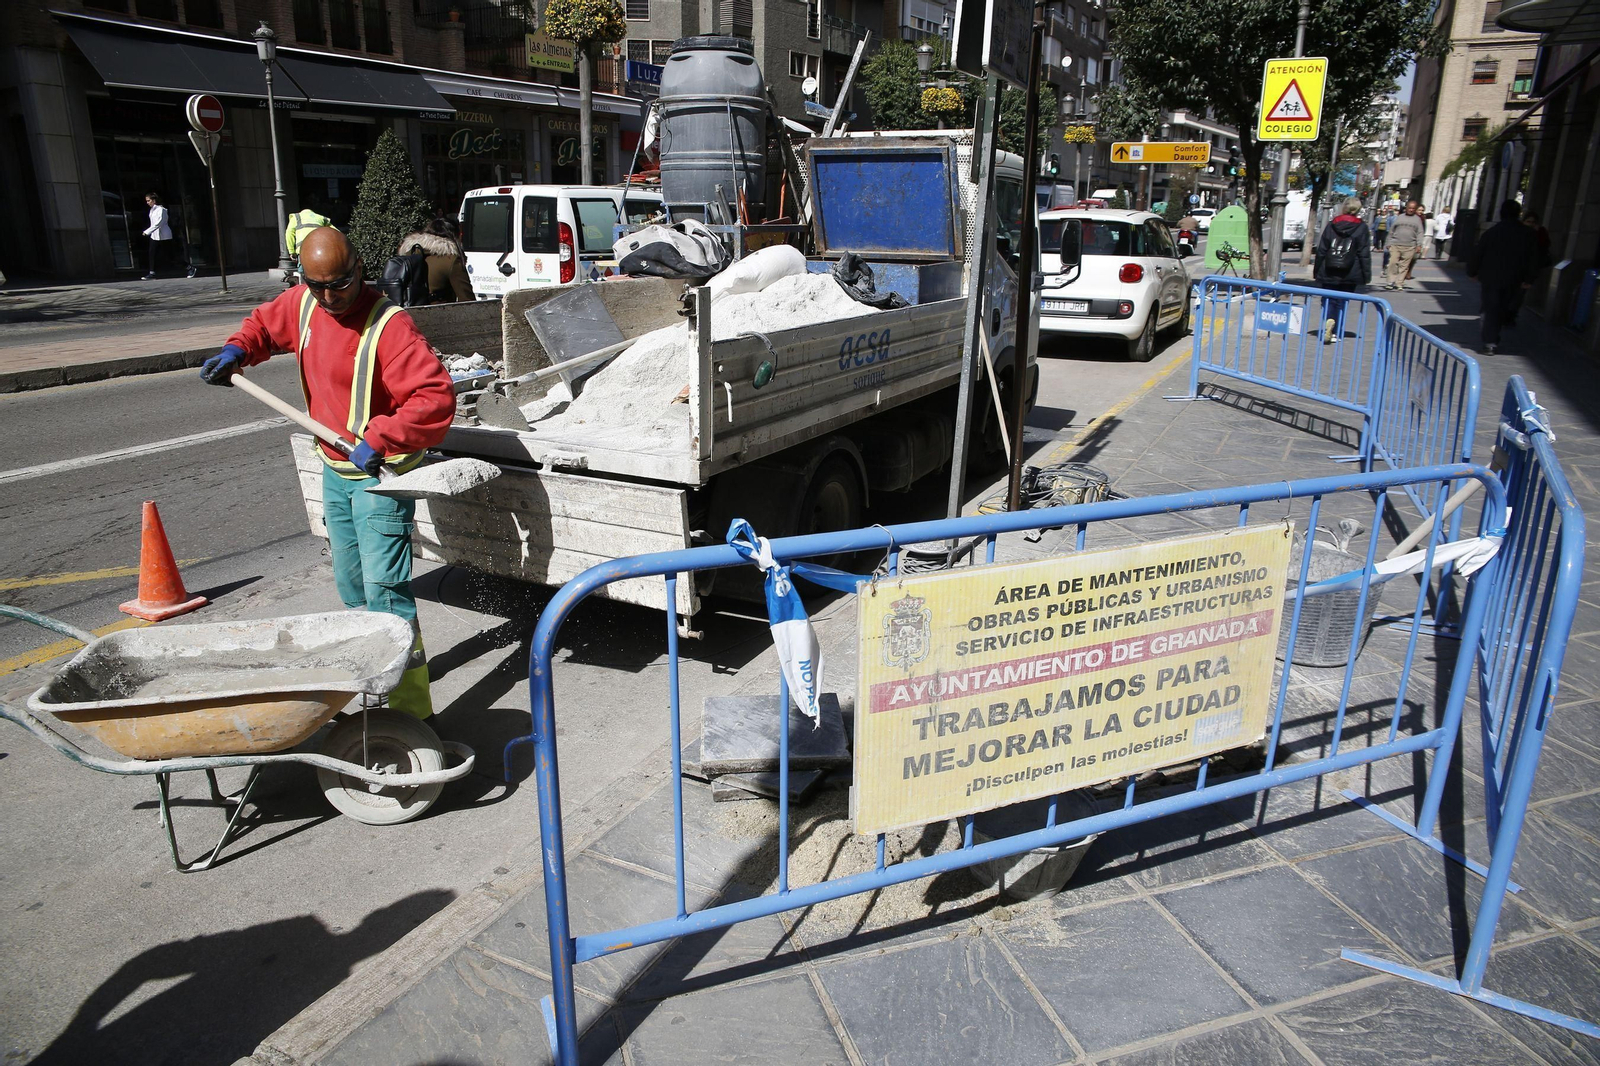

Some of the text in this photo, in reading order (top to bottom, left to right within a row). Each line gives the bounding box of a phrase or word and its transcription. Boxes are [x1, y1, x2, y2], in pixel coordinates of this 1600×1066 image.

[529, 37, 572, 58] Las almenas
[547, 59, 571, 69] ENTRADA
[1269, 63, 1323, 74] ATENCIÓN
[493, 91, 523, 101] CHURROS
[455, 110, 494, 124] PIZZERIA
[567, 121, 573, 130] Y
[1265, 124, 1312, 133] COLEGIO
[447, 127, 503, 161] Desi
[1173, 153, 1199, 161] Dauro
[1046, 300, 1086, 311] 9111 JRH
[839, 328, 891, 371] acsa
[994, 551, 1247, 606] ÁREA DE MANTENIMIENTO,
[967, 566, 1268, 632] OBRAS PÚBLICAS Y URBANISMO
[955, 585, 1274, 656] SERVICIO DE INFRAESTRUCTURAS
[888, 617, 1260, 706] AYUNTAMIENTO DE GRANADA
[912, 655, 1232, 742] TRABAJAMOS PARA
[903, 684, 1242, 780] MEJORAR LA CIUDAD
[965, 728, 1189, 797] ¡Disculpen las molestias!
